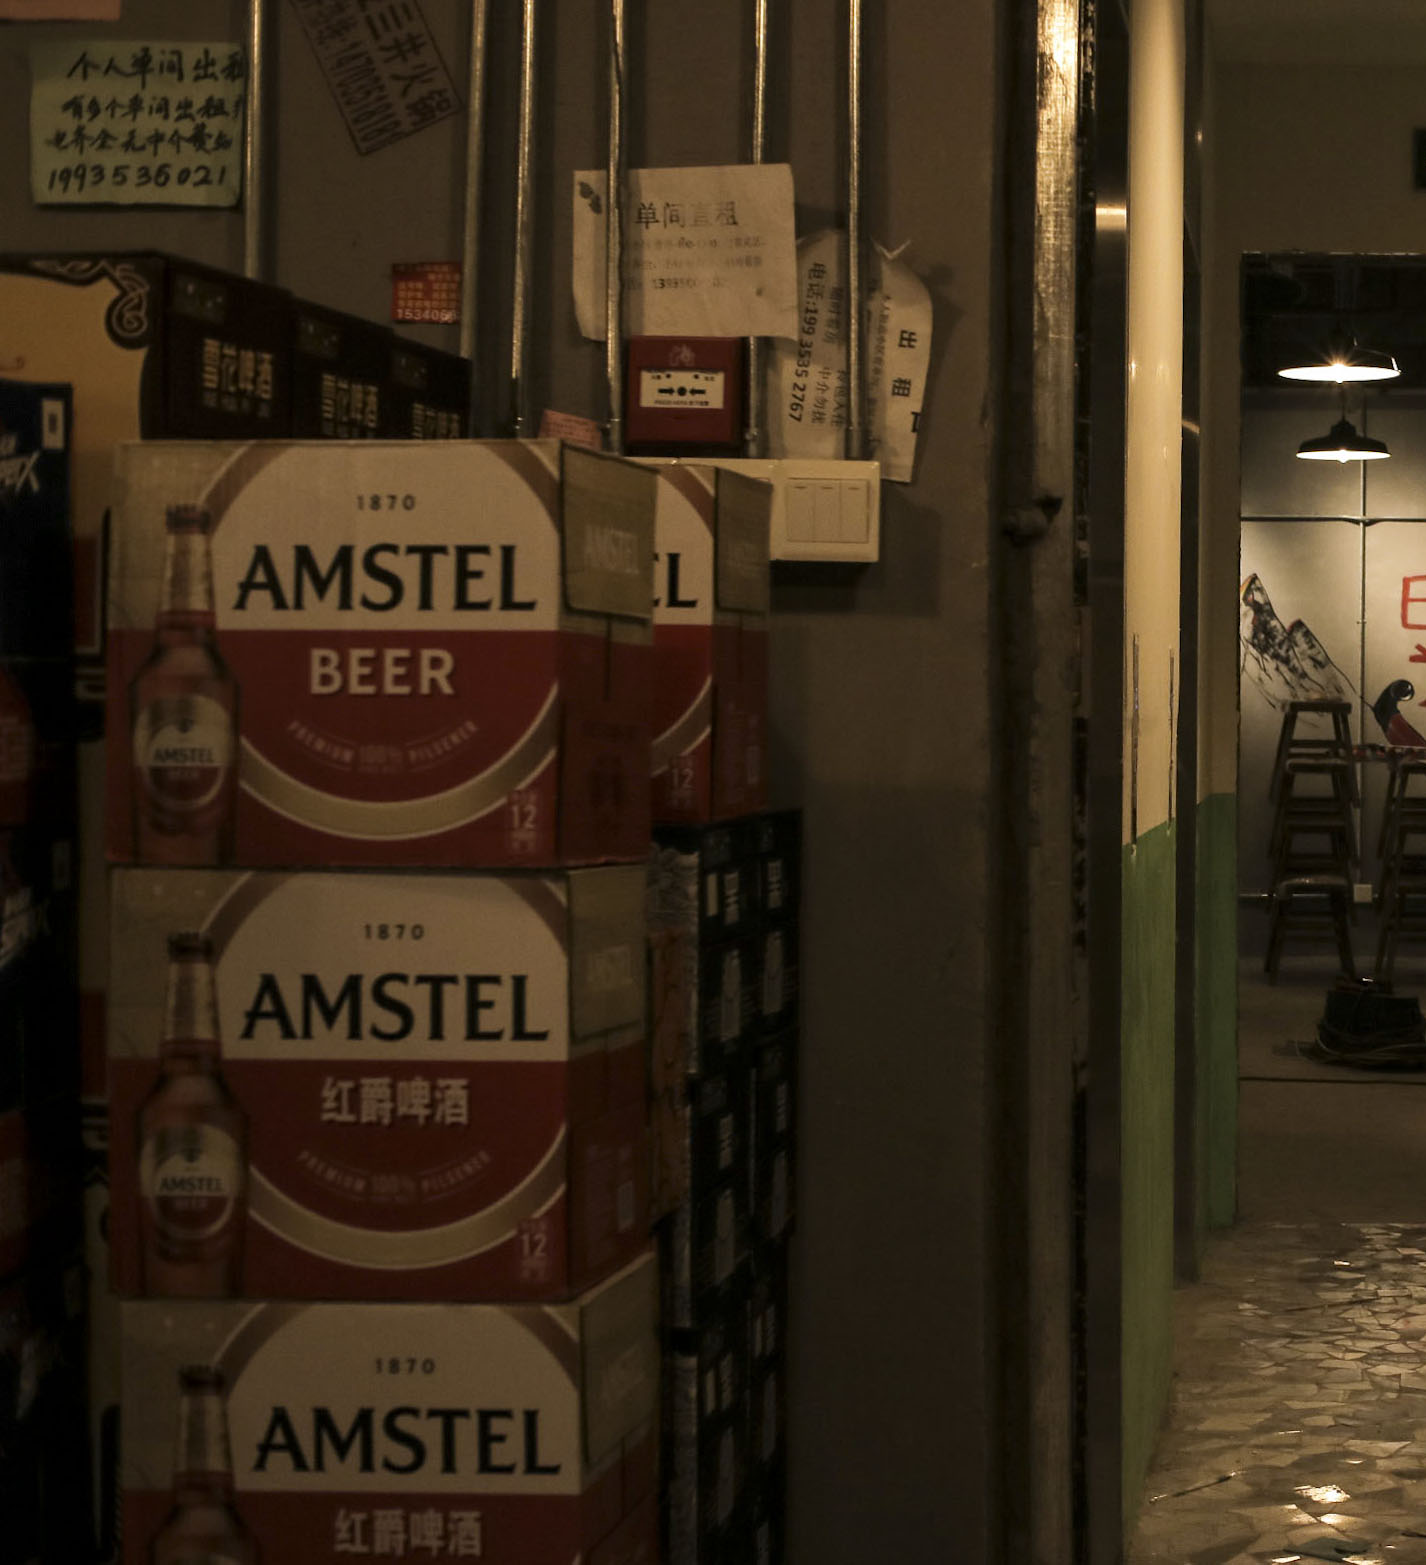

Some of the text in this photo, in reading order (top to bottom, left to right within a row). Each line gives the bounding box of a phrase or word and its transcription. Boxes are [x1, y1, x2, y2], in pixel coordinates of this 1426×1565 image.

[788, 382, 807, 423] 2767
[357, 495, 415, 511] 1870
[232, 544, 537, 612] AMSTEL
[310, 648, 455, 696] BEER
[512, 804, 537, 829] 12
[364, 924, 424, 940] 1870
[240, 973, 551, 1043] AMSTEL
[321, 1076, 470, 1128] 红爵啤酒
[521, 1231, 547, 1257] 12
[376, 1358, 435, 1375] 1870
[254, 1408, 562, 1478] AMSTEL
[333, 1508, 482, 1560] 红爵啤酒
